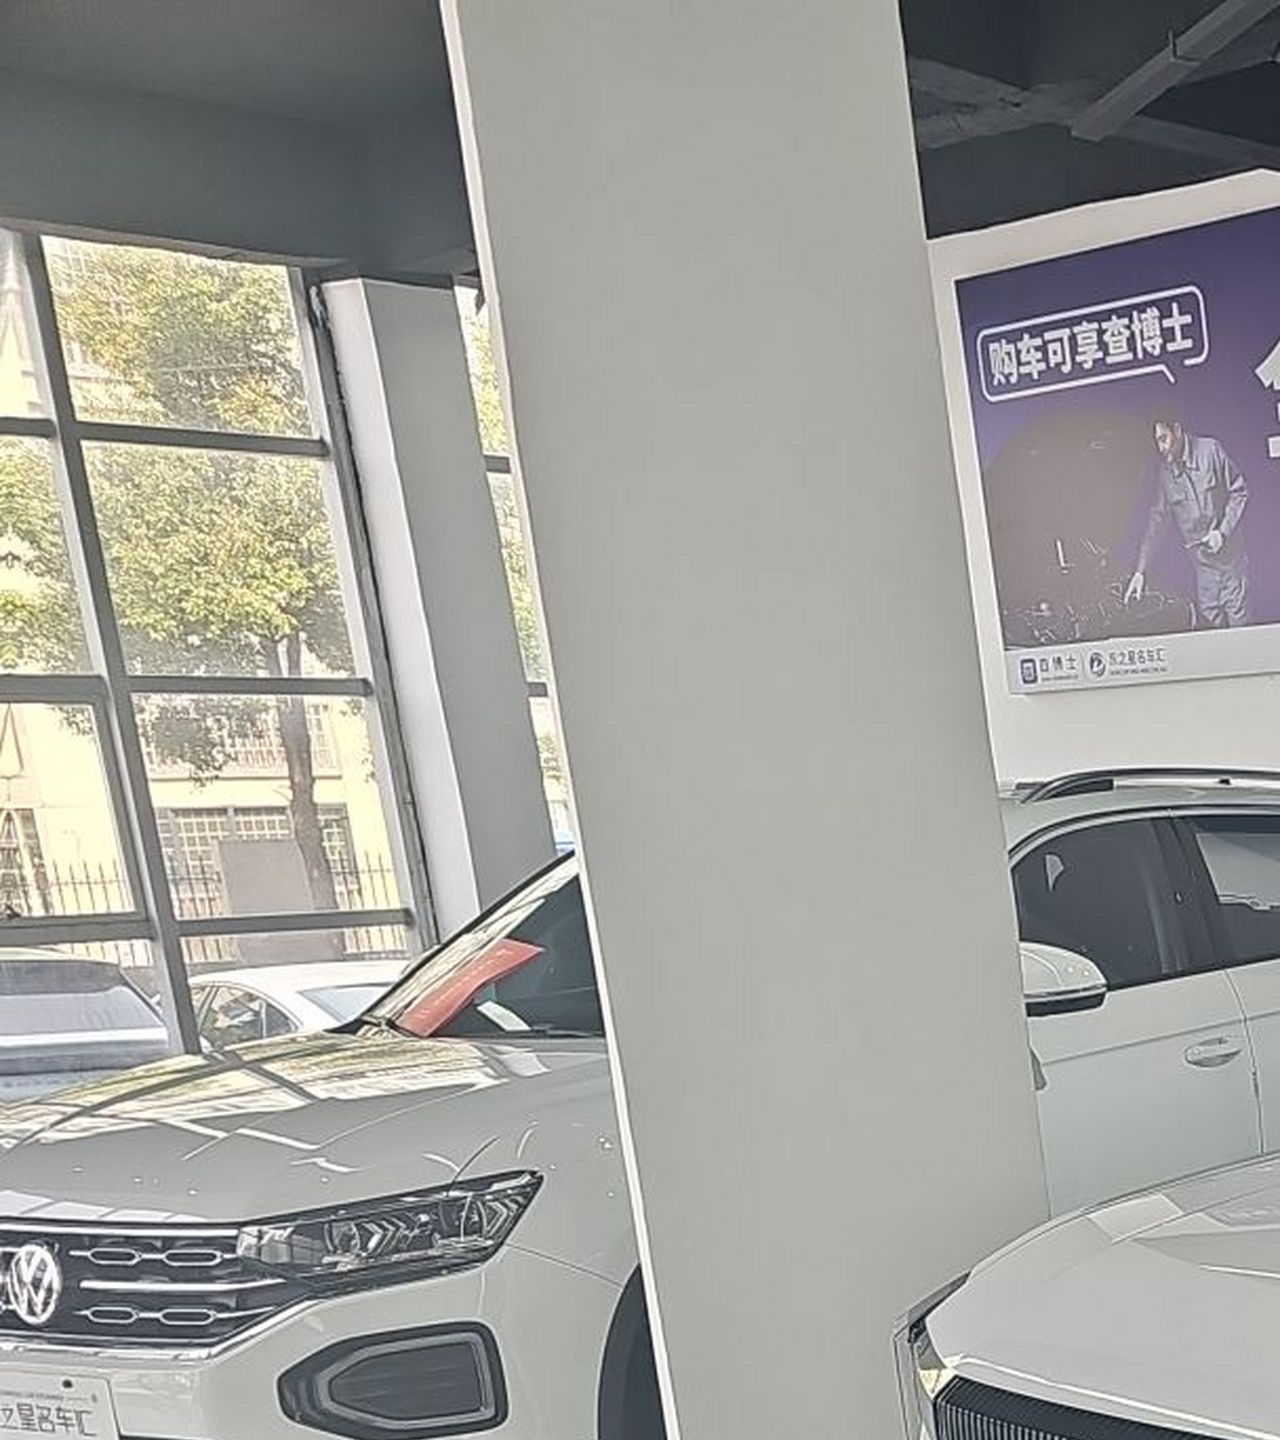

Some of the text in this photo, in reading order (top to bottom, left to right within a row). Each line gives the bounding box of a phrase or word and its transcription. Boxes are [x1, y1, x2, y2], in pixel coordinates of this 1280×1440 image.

[988, 302, 1193, 387] 购车可享查博士
